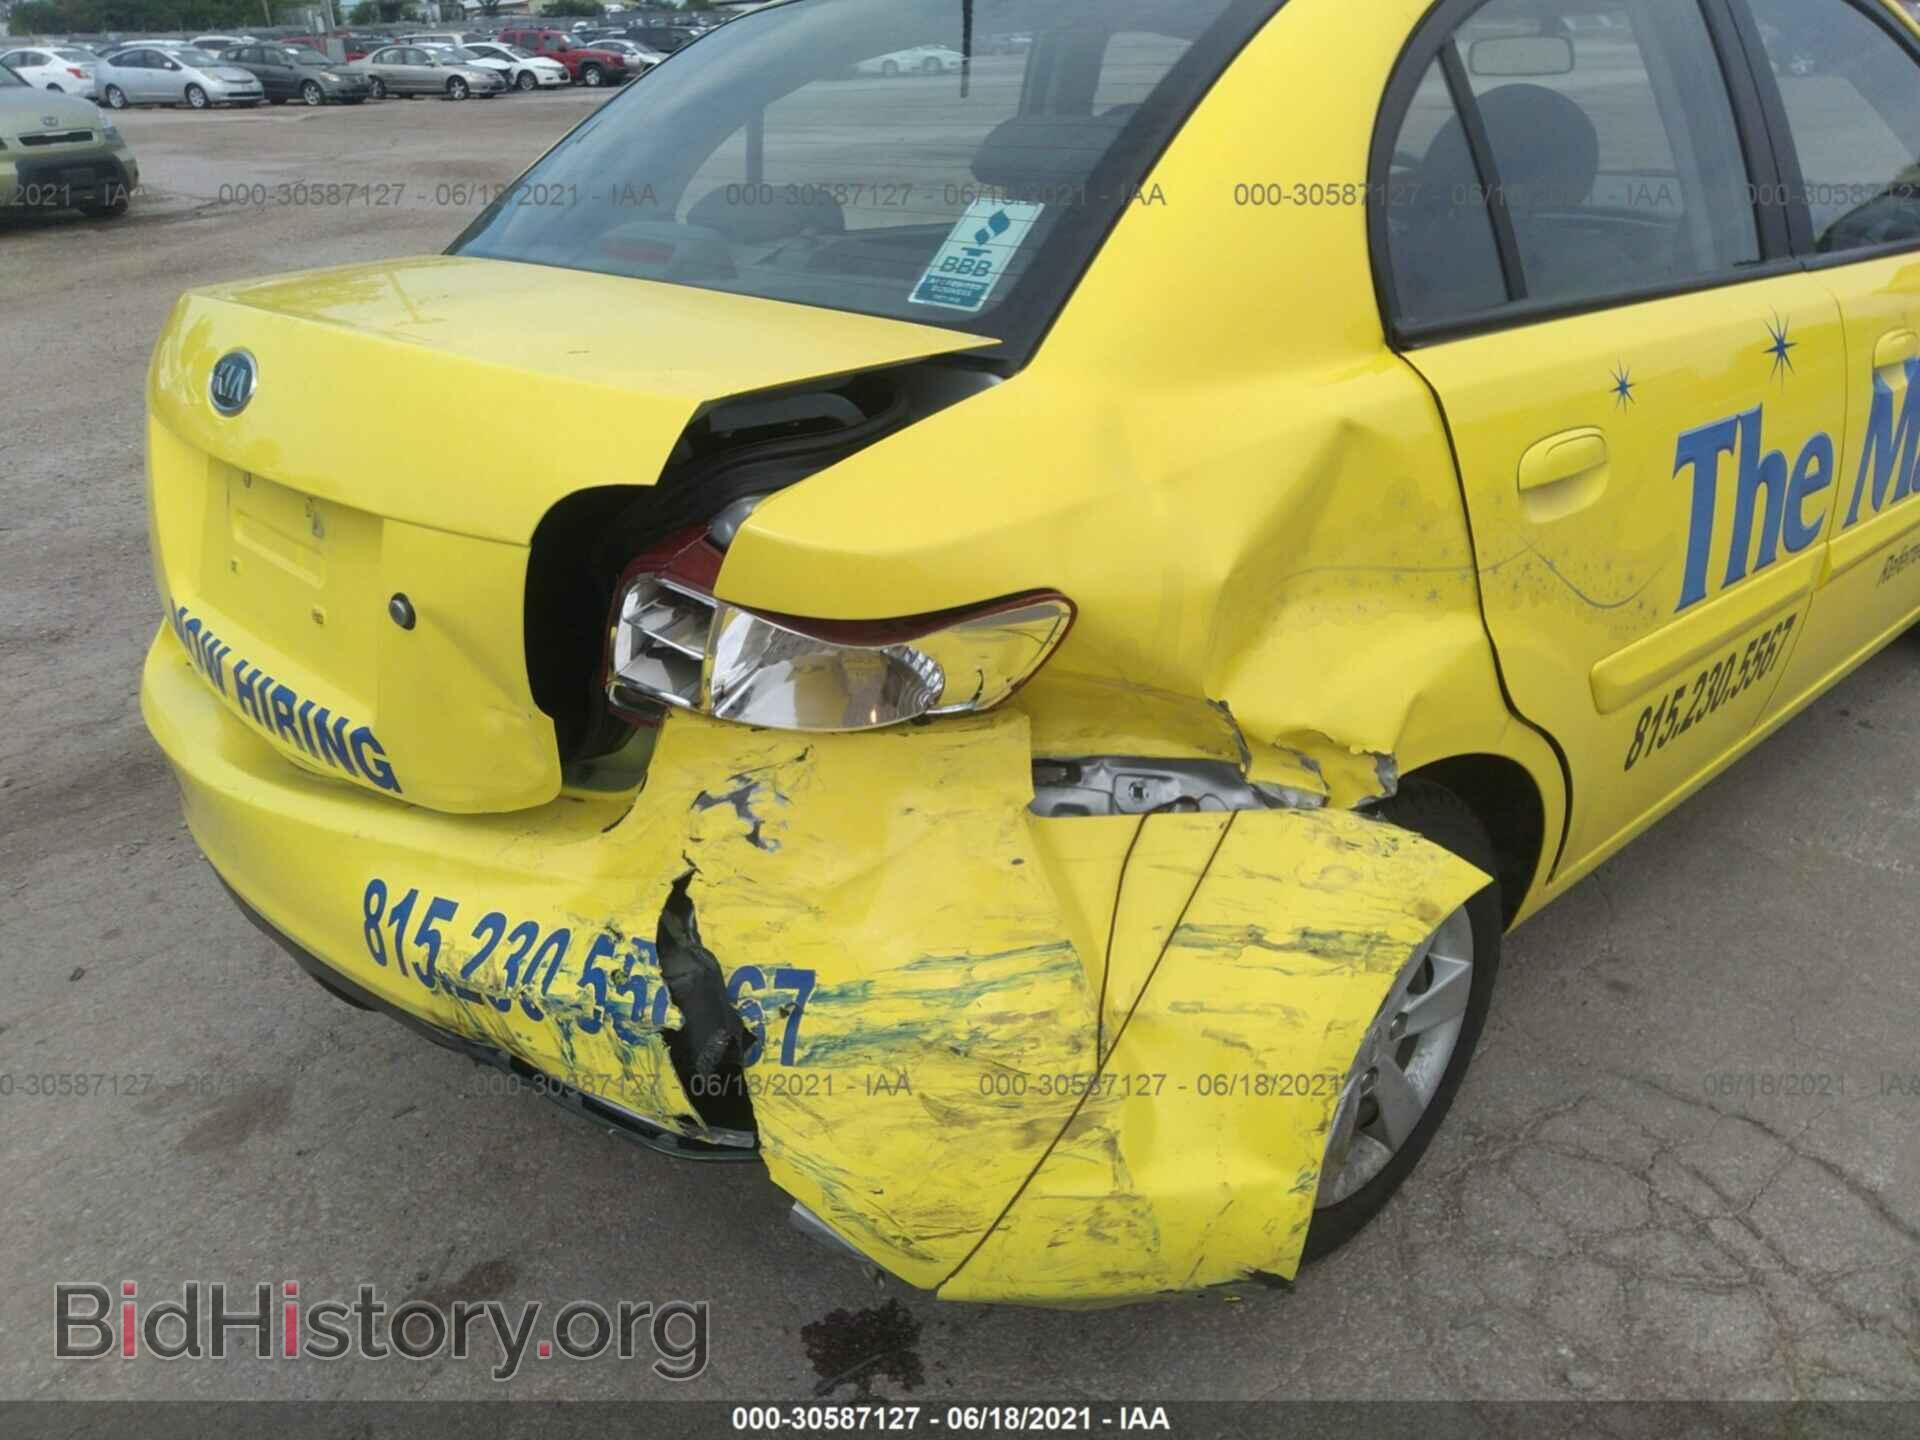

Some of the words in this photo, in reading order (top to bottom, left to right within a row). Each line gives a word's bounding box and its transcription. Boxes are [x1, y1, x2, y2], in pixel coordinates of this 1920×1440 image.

[940, 256, 992, 277] BBB
[1672, 402, 1833, 614] The
[232, 659, 403, 794] HIRING
[1624, 612, 1797, 772] 815.230.5567
